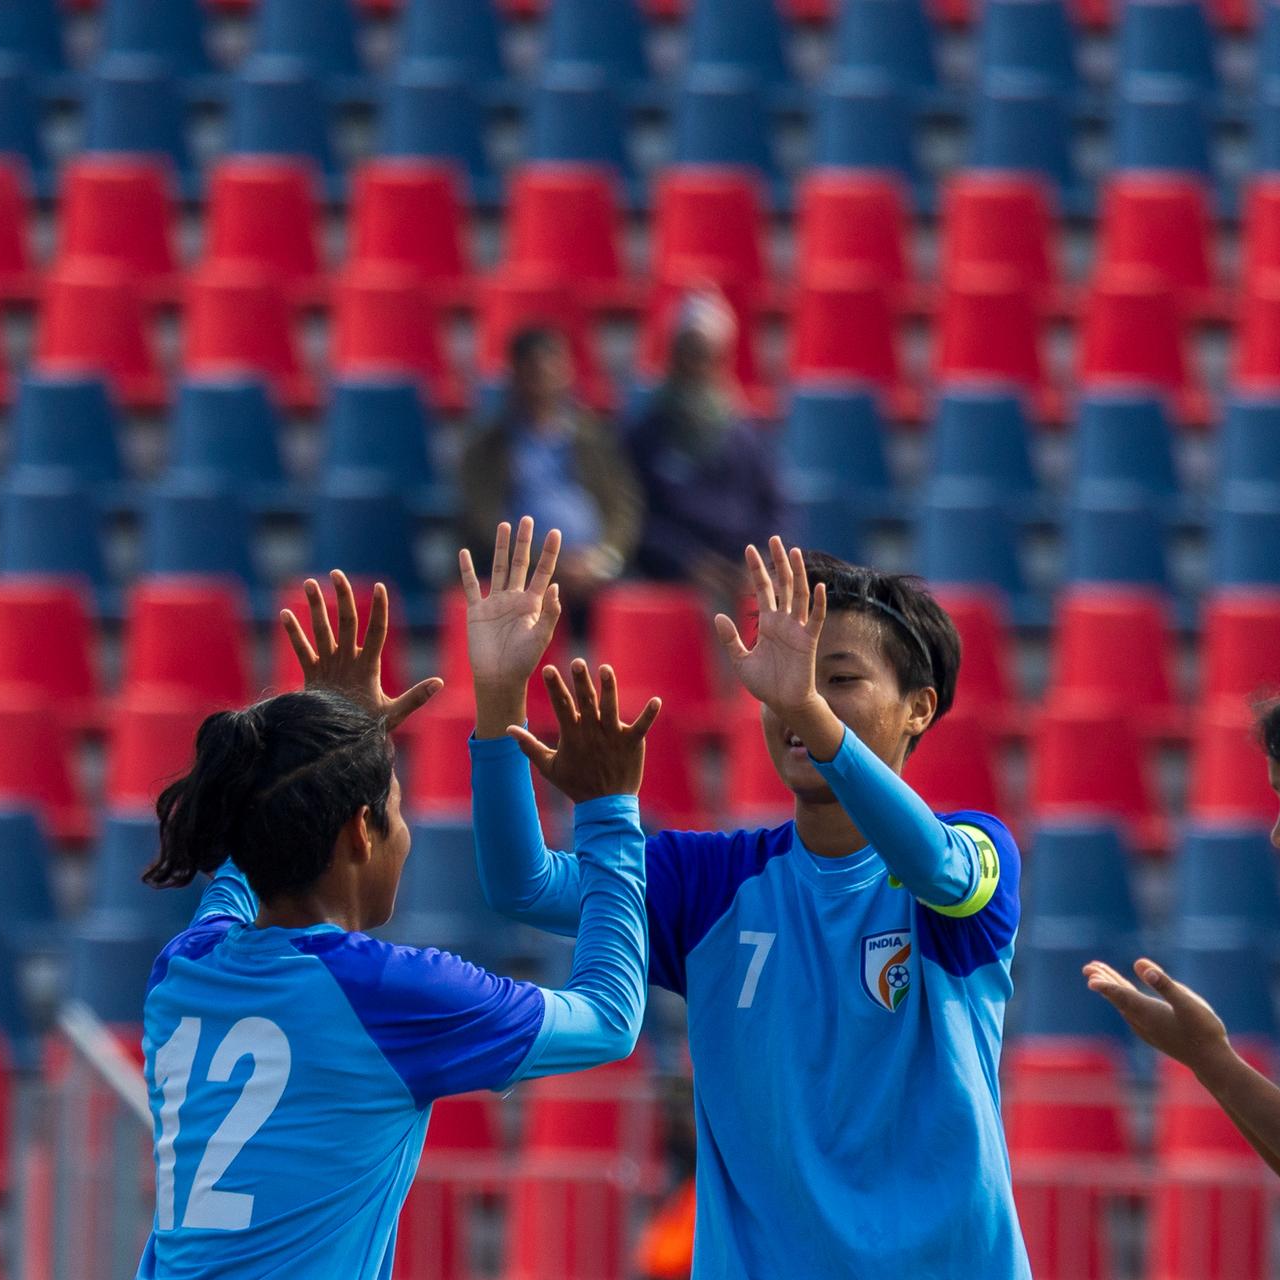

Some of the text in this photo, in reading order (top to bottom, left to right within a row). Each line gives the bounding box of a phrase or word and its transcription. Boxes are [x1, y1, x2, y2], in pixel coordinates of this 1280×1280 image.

[736, 931, 777, 1009] 7
[868, 937, 903, 951] INDIA
[154, 1016, 292, 1231] 12
